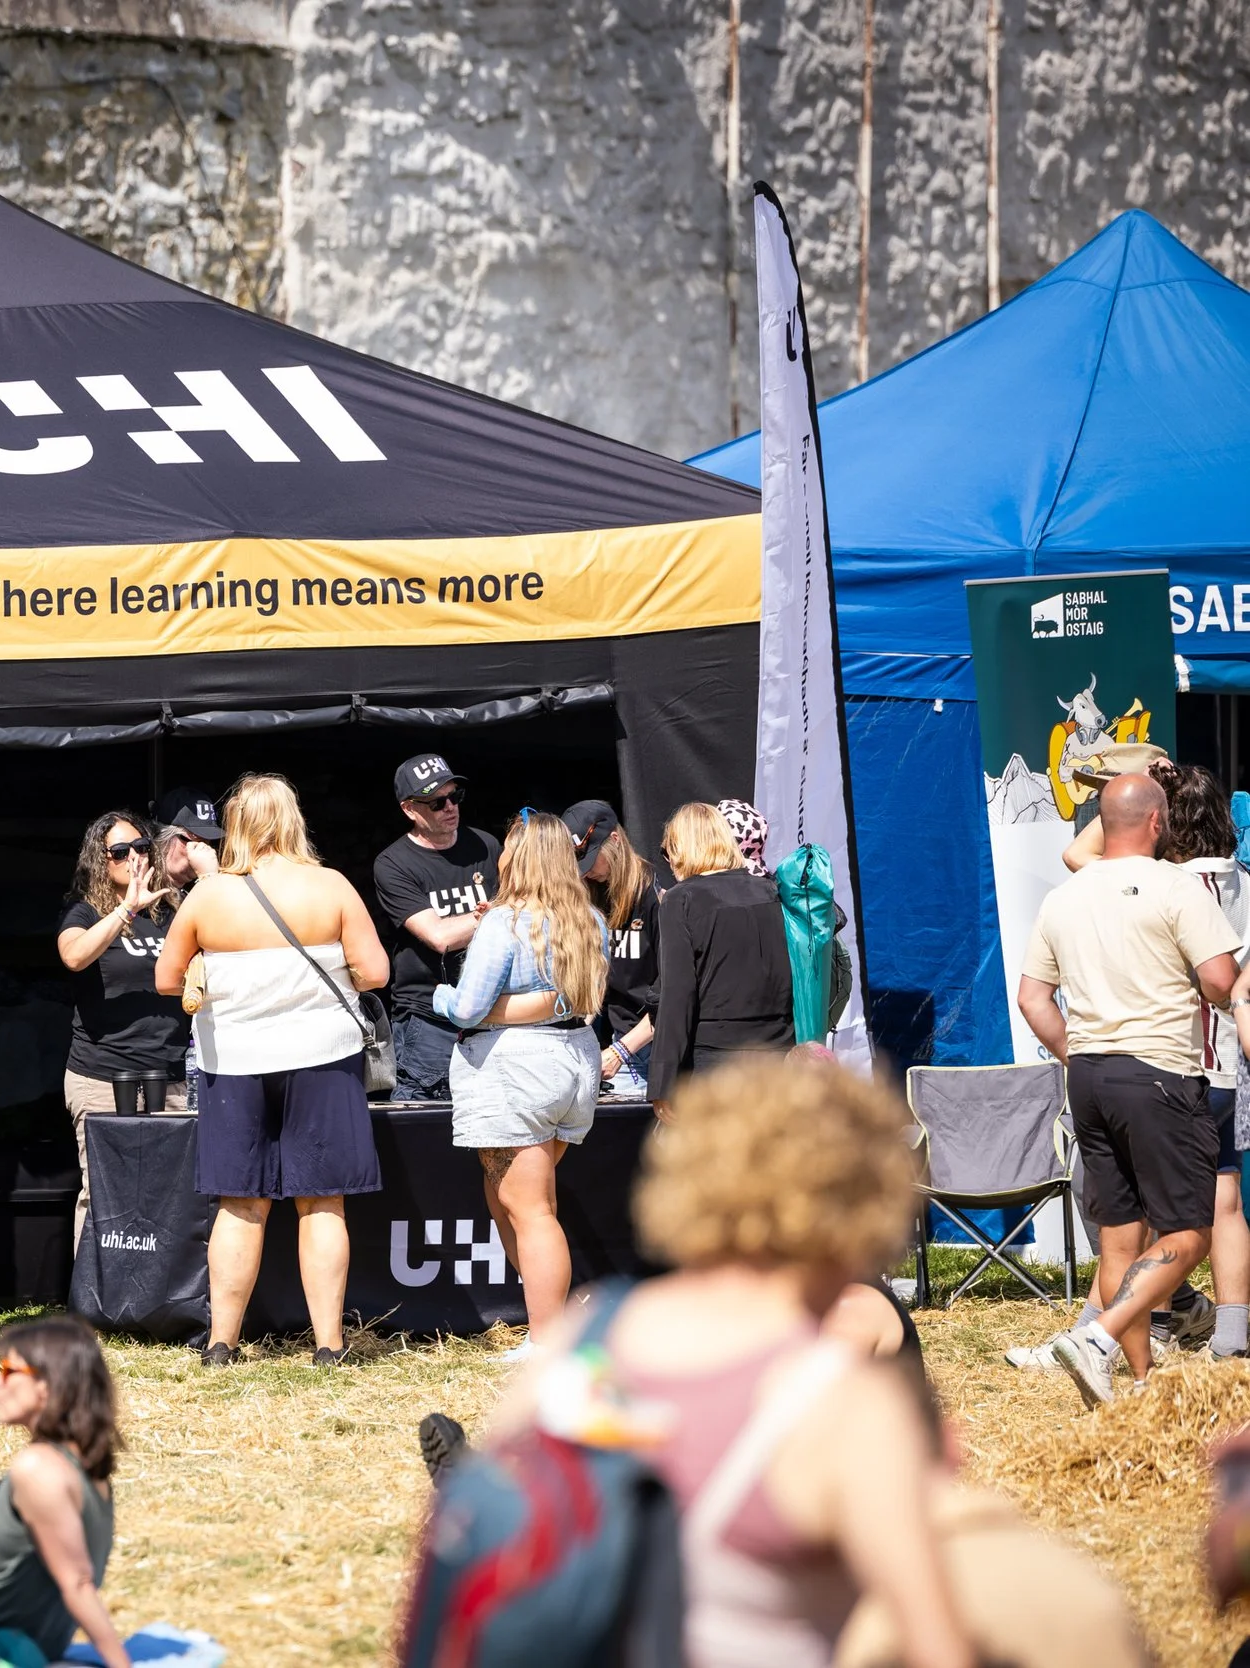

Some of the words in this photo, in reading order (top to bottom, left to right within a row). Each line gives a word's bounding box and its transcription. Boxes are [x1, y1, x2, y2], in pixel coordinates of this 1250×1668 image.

[110, 571, 279, 616] learning
[291, 574, 427, 606] means
[438, 571, 545, 604] more
[1065, 590, 1107, 606] SABHAL
[1065, 604, 1088, 621] MÒR
[1066, 621, 1104, 637] OSTAIG
[412, 757, 449, 780] UHI
[429, 884, 488, 917] UHI
[121, 936, 165, 957] UH
[100, 1231, 157, 1253] uhi.ac.uk
[390, 1219, 523, 1287] UH
